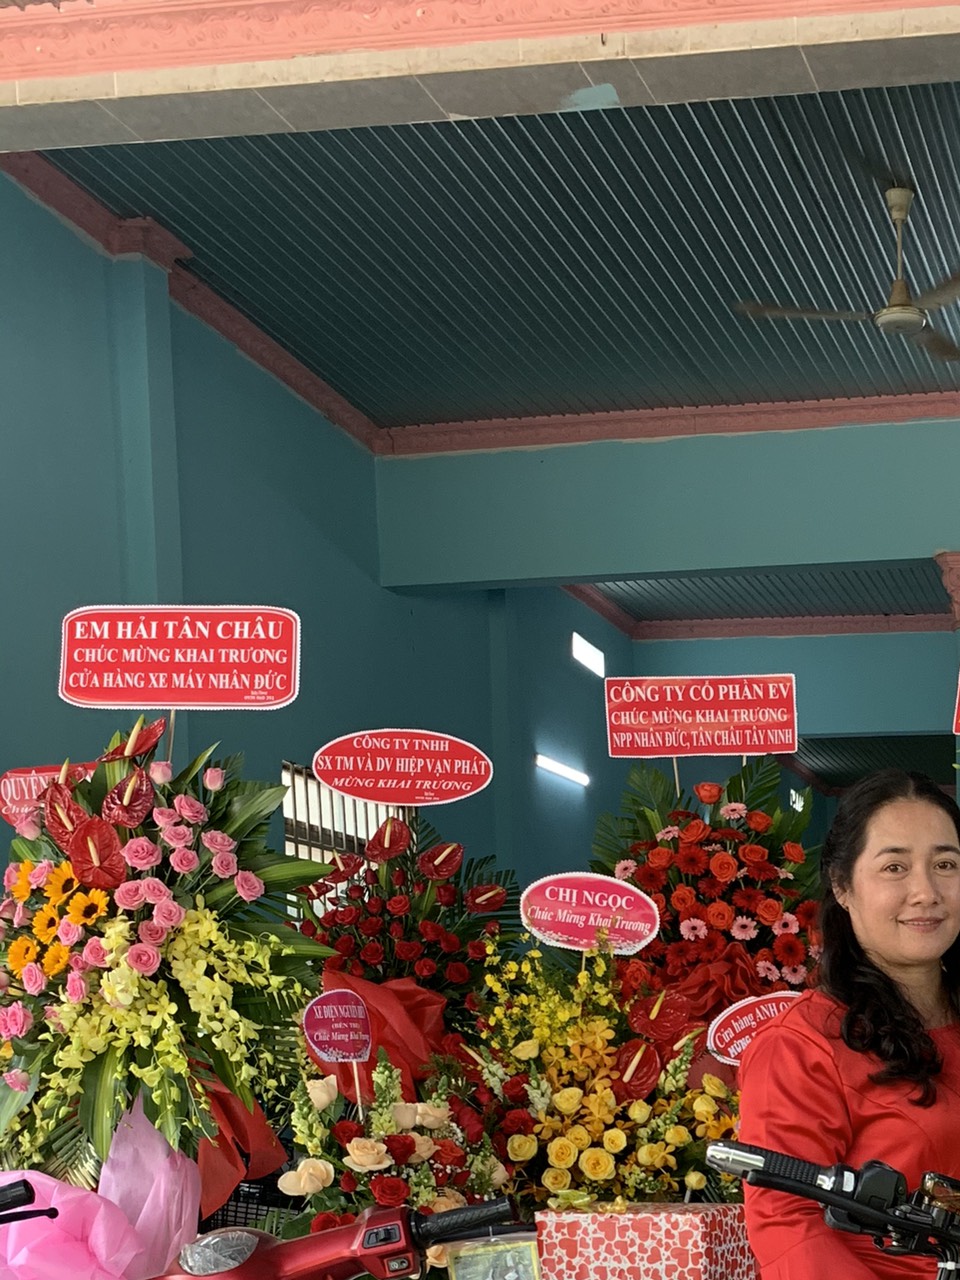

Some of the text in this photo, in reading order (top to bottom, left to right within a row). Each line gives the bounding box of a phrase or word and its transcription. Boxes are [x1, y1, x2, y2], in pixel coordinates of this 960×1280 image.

[74, 616, 284, 640] EM HẢI TÂN CHÂU
[73, 644, 288, 664] CHÚC MỪNG KHAI TRƯƠNG
[69, 668, 287, 690] CỬA HÀNG XE MÁY NHÂN ĐỨC
[609, 679, 791, 703] CÔNG TY CỔ PHẦN EV
[611, 707, 788, 725] CHÚC MỪNG KHAI TRƯƠNG
[353, 735, 449, 751] CÔNG TY TNHH
[612, 726, 793, 750] NPP NHÂN ĐỨC, TÂN CHÂU TÂY NINH
[317, 752, 488, 777] SX TM VÀ DV HIỆP VẠN PHÁT
[331, 775, 473, 791] MỪNG KHAI TRƯƠNG
[545, 886, 635, 912] CHỊ NGỌC
[527, 905, 652, 935] Chúc Mừng Khai Trương
[731, 1013, 757, 1033] hàng
[755, 1002, 778, 1021] ANH
